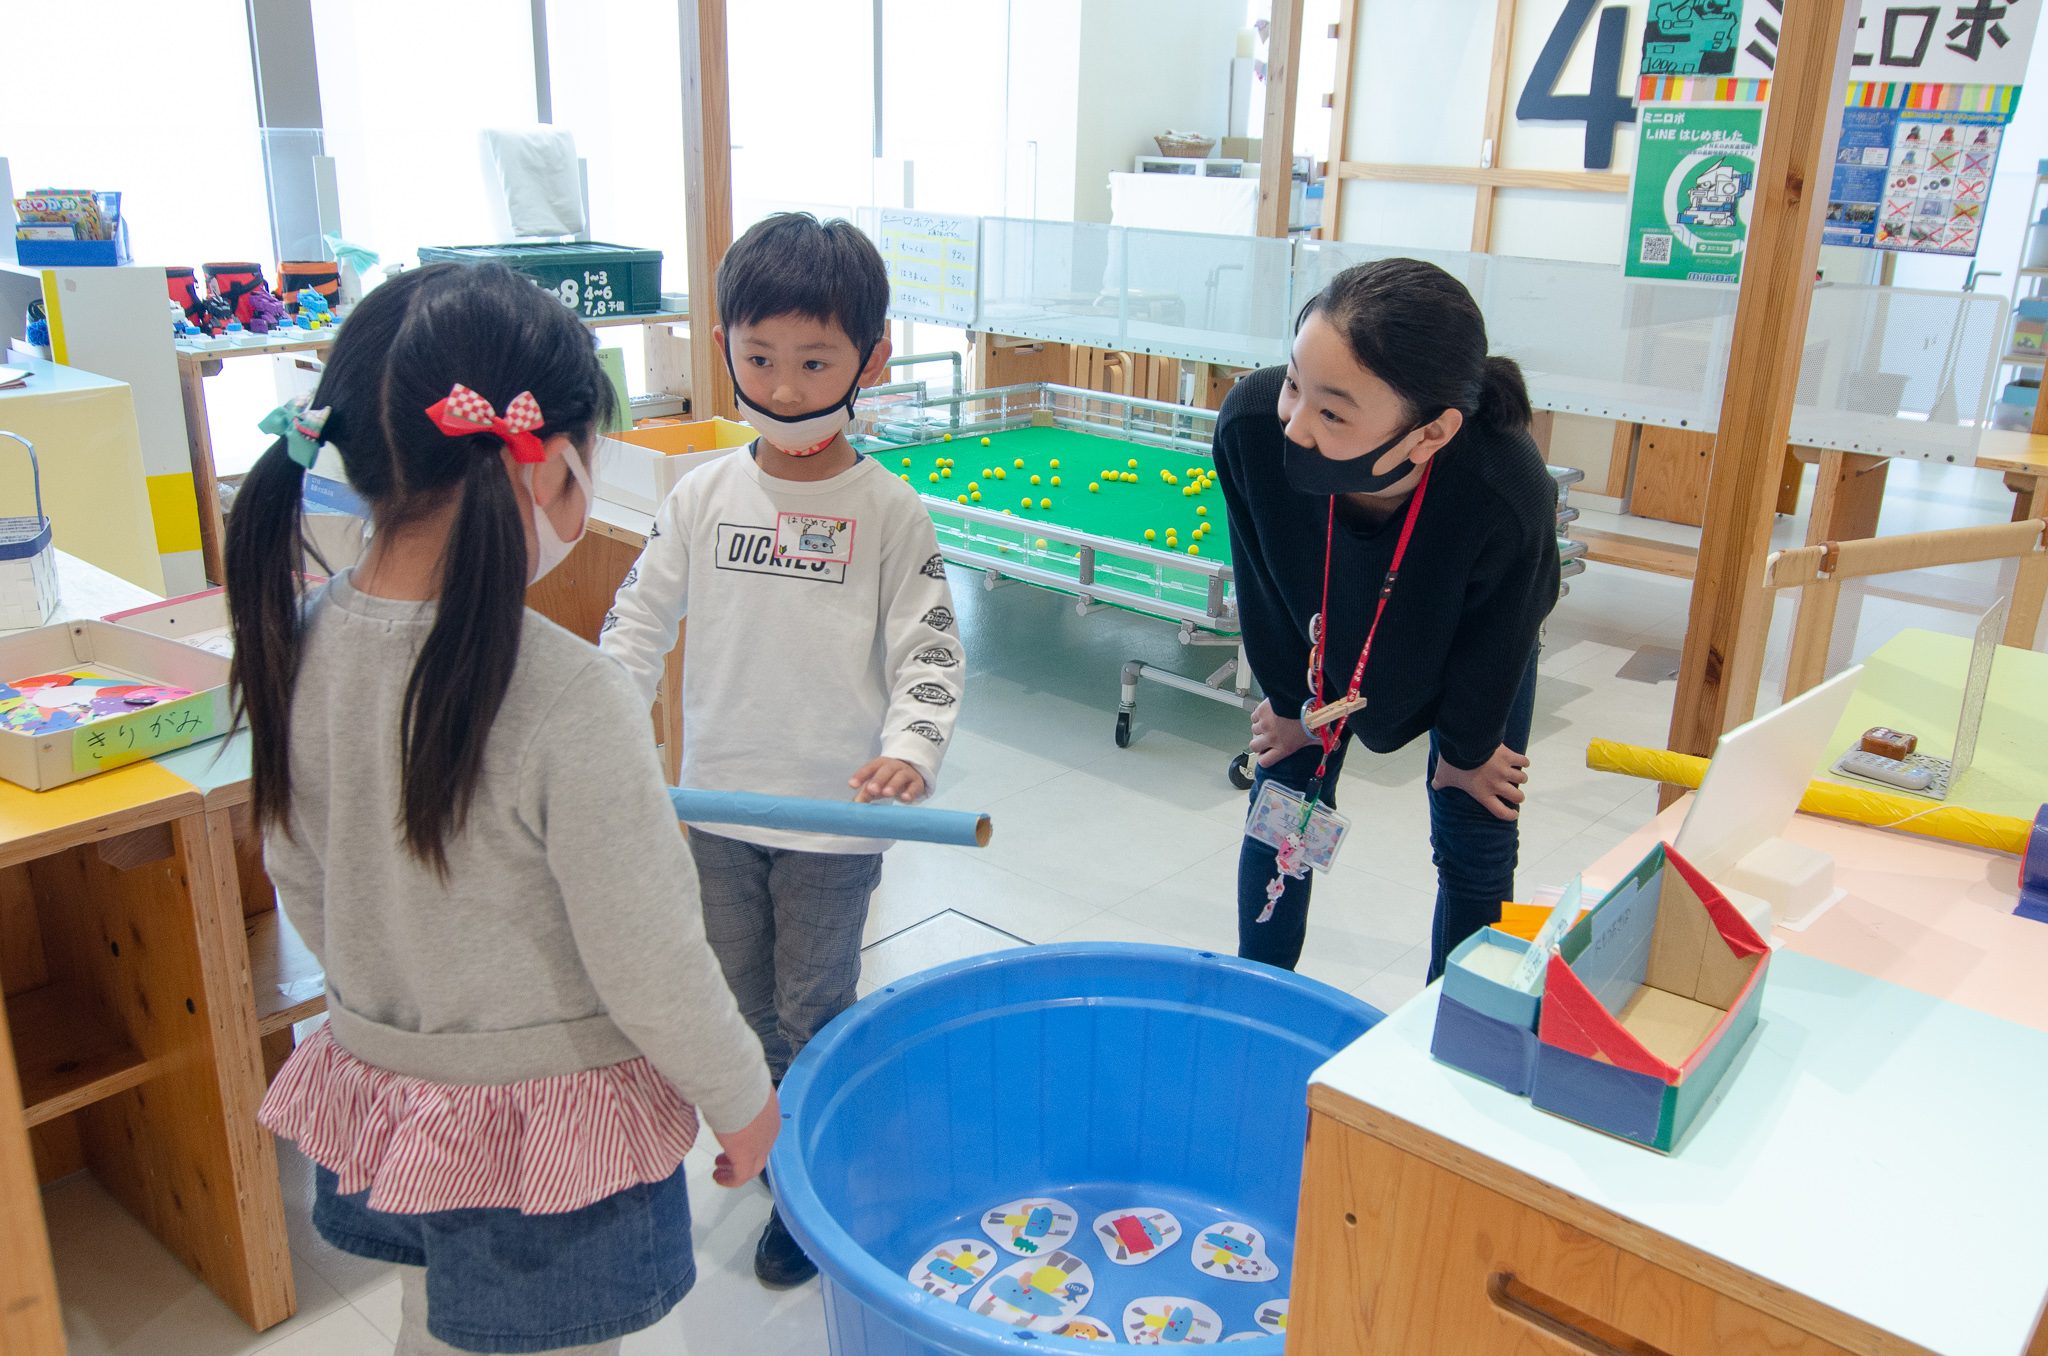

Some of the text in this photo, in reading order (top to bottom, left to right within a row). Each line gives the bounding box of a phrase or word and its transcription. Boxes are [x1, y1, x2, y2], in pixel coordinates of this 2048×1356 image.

[1516, 0, 1637, 168] 4
[1644, 112, 1685, 123] ミニロボ
[1646, 129, 1743, 141] LINE はじめました
[787, 516, 828, 529] はじめて
[86, 709, 203, 760] きりがみ
